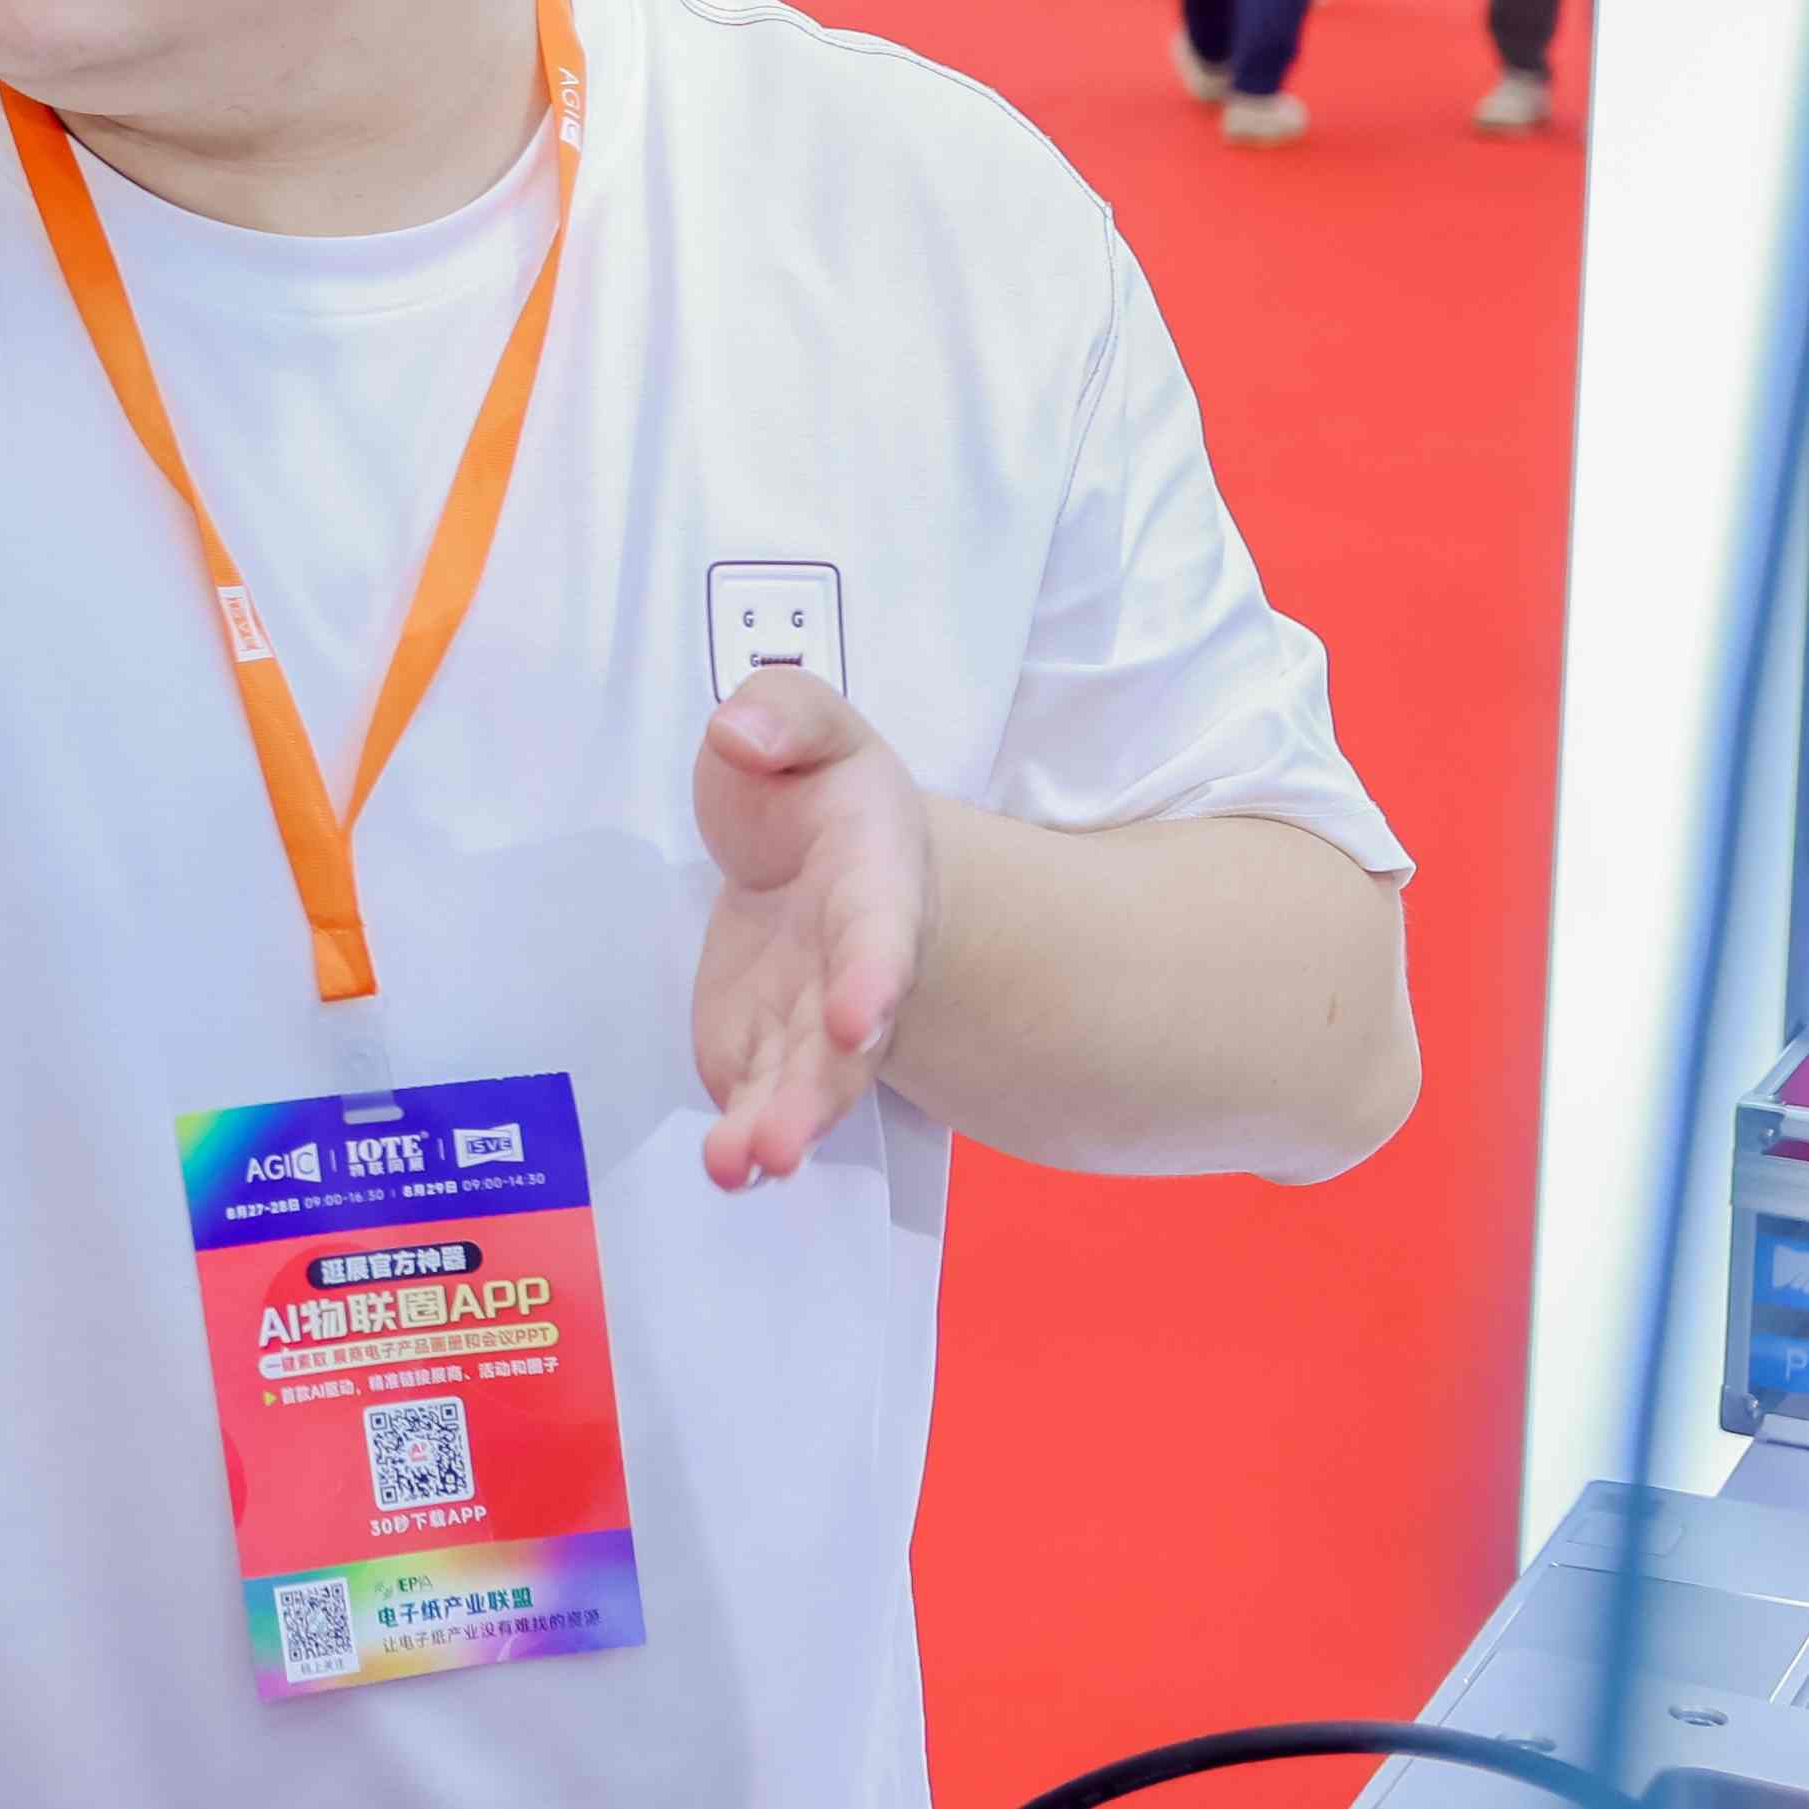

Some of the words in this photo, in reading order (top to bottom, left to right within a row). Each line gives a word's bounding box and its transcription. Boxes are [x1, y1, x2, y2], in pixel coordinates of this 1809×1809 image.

[246, 1142, 322, 1184] AGIC
[467, 1138, 513, 1155] ISVE
[321, 1244, 467, 1285] 逛展官方神器
[258, 1276, 552, 1347] AI物联圈APP
[369, 1505, 488, 1537] 30秒下载APP
[377, 1586, 534, 1629] 电子纸产业联盟
